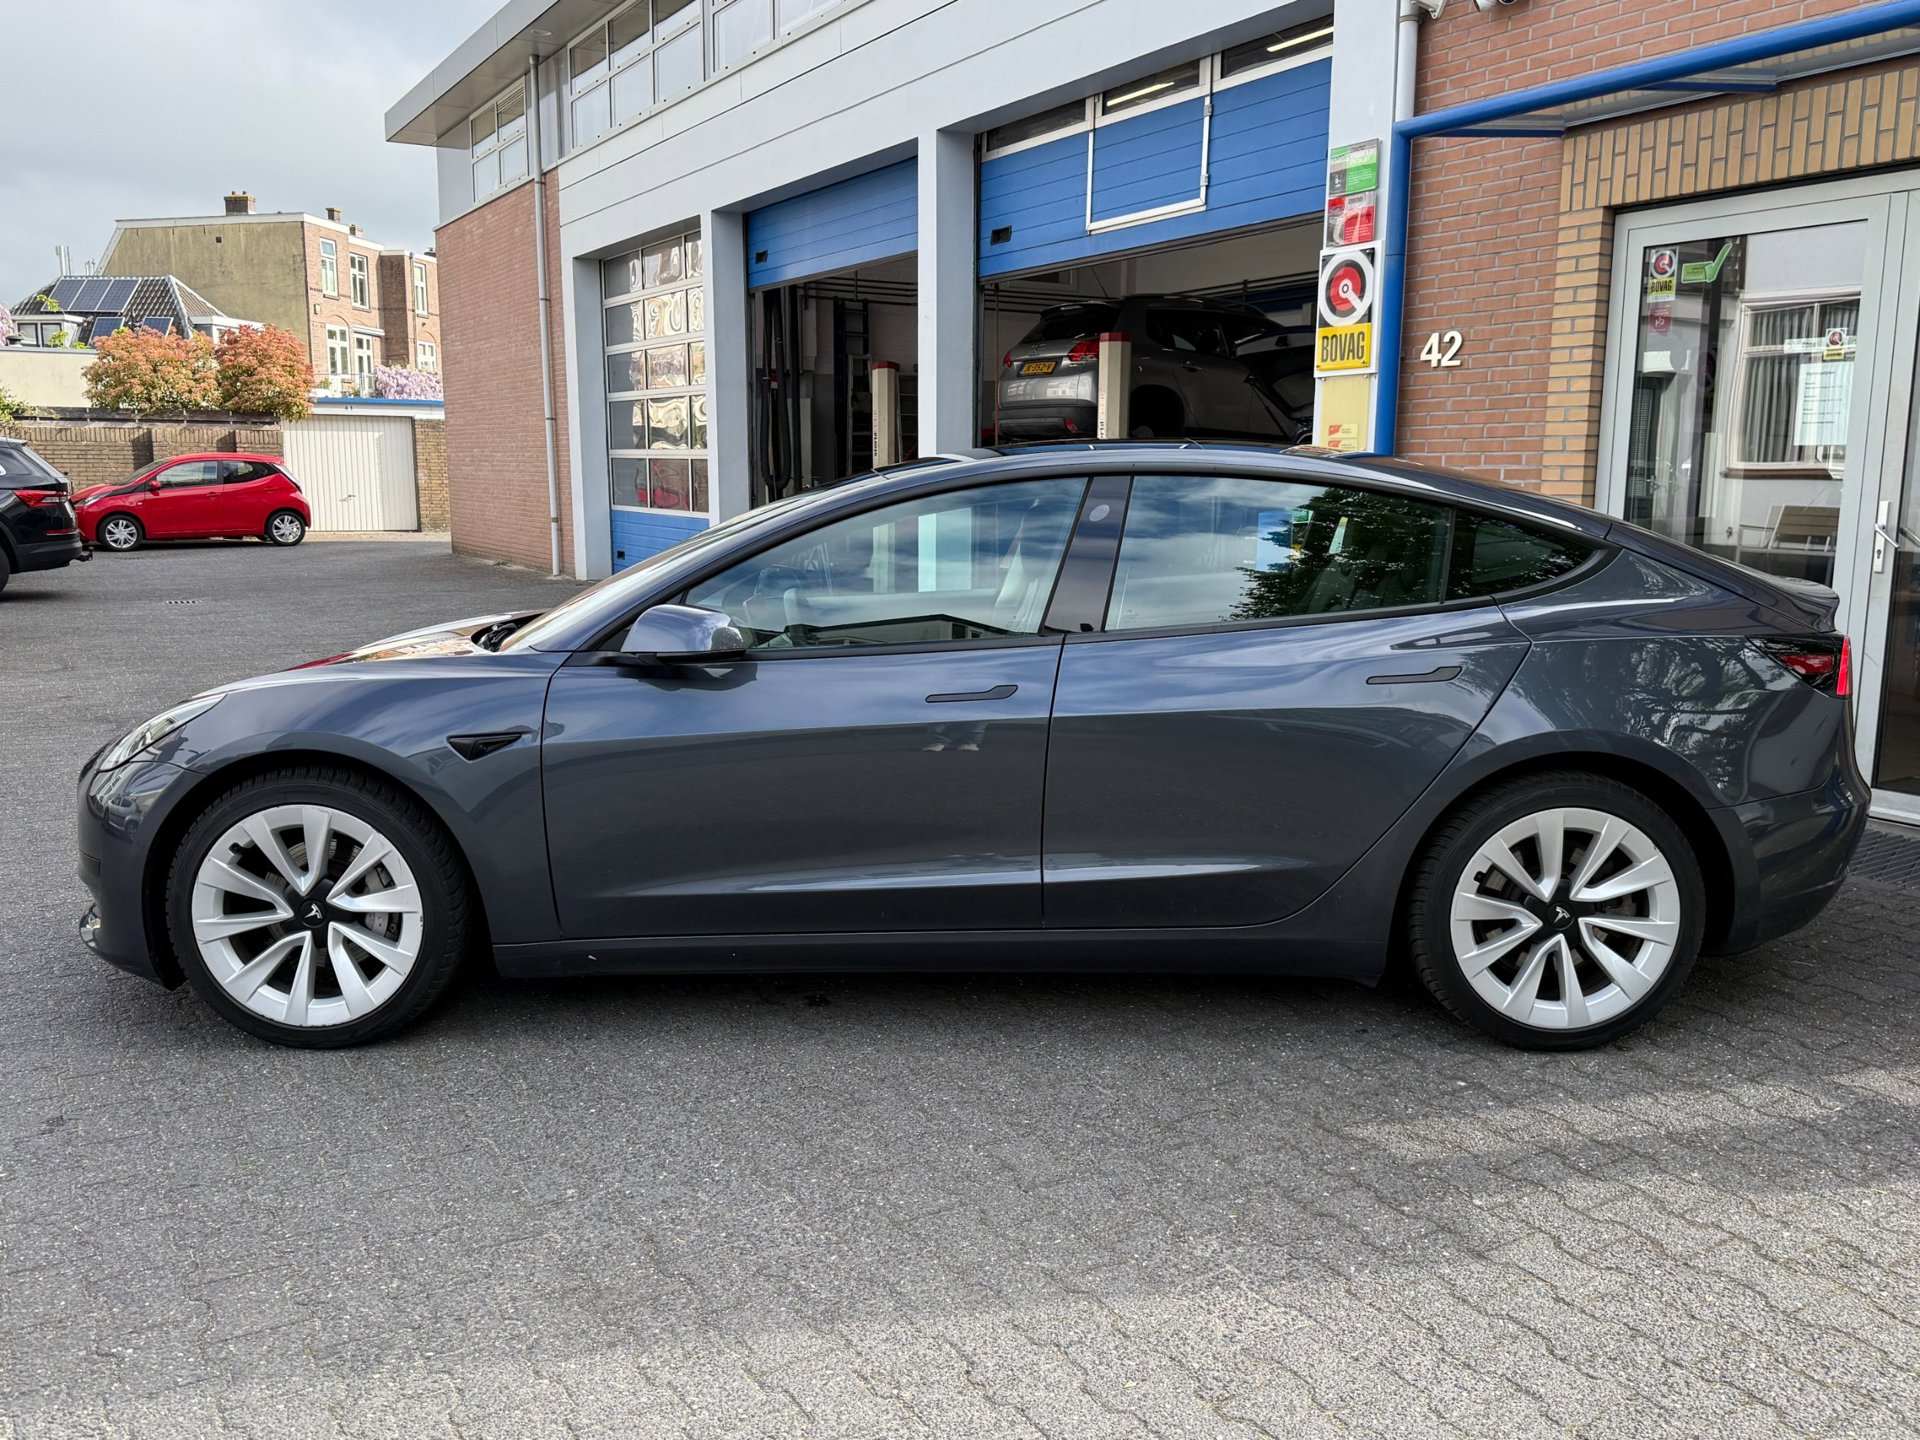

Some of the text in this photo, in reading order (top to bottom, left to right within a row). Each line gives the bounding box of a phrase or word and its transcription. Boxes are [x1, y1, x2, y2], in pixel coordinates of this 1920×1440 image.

[1651, 280, 1672, 293] BOVAG
[1321, 331, 1365, 362] BOVAG
[1420, 330, 1462, 367] 42
